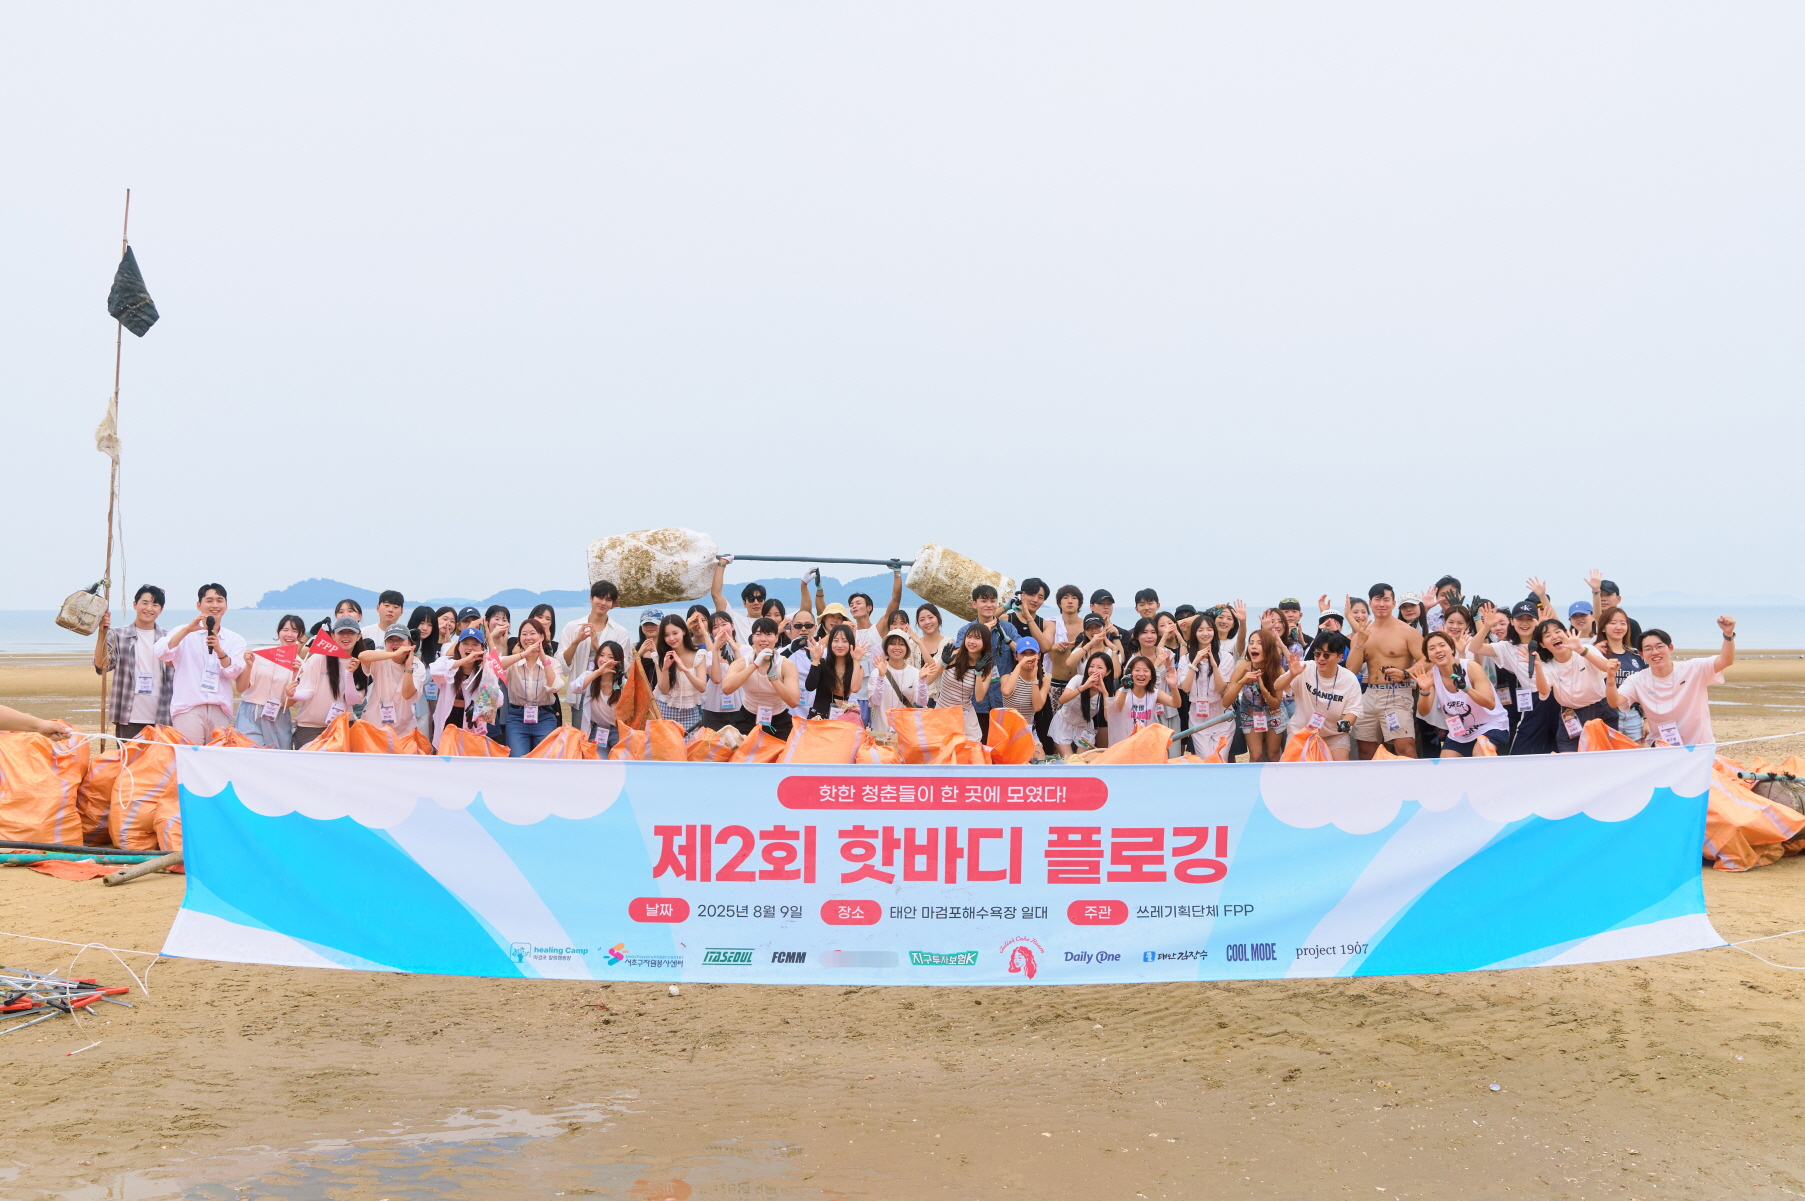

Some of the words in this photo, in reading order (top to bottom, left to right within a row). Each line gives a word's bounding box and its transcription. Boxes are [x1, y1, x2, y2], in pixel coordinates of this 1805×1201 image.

[317, 638, 339, 653] FPP
[1312, 688, 1344, 702] SANDER
[819, 785, 855, 803] 핫한
[861, 785, 934, 803] 청춘들이
[941, 785, 959, 803] 한
[964, 785, 1000, 803] 곳에
[1006, 785, 1067, 803] 모였다!
[652, 824, 817, 884] 제2회
[838, 824, 1023, 885] 핫바디
[1044, 825, 1229, 884] 플로깅
[645, 903, 673, 917] 날짜
[697, 904, 749, 918] 2025년
[753, 904, 776, 918] 8월
[780, 905, 803, 918] 9일
[837, 905, 865, 919] 장소
[890, 905, 917, 920] 태안
[921, 905, 1017, 920] 마검포해수욕장
[1021, 905, 1048, 920] 일대
[1084, 905, 1112, 920] 주관
[1136, 904, 1219, 919] 쓰레기획단체
[1224, 904, 1254, 917] FPP
[534, 946, 564, 955] healing
[565, 947, 589, 955] Camp
[703, 950, 753, 963] ITASEOUL
[771, 951, 807, 964] FCMM
[1064, 951, 1093, 964] Daily
[1226, 944, 1249, 962] COOL
[1250, 943, 1277, 961] MODE
[1295, 945, 1336, 960] project
[1340, 941, 1369, 955] 1907
[624, 959, 684, 968] 서초구자원봉사센터
